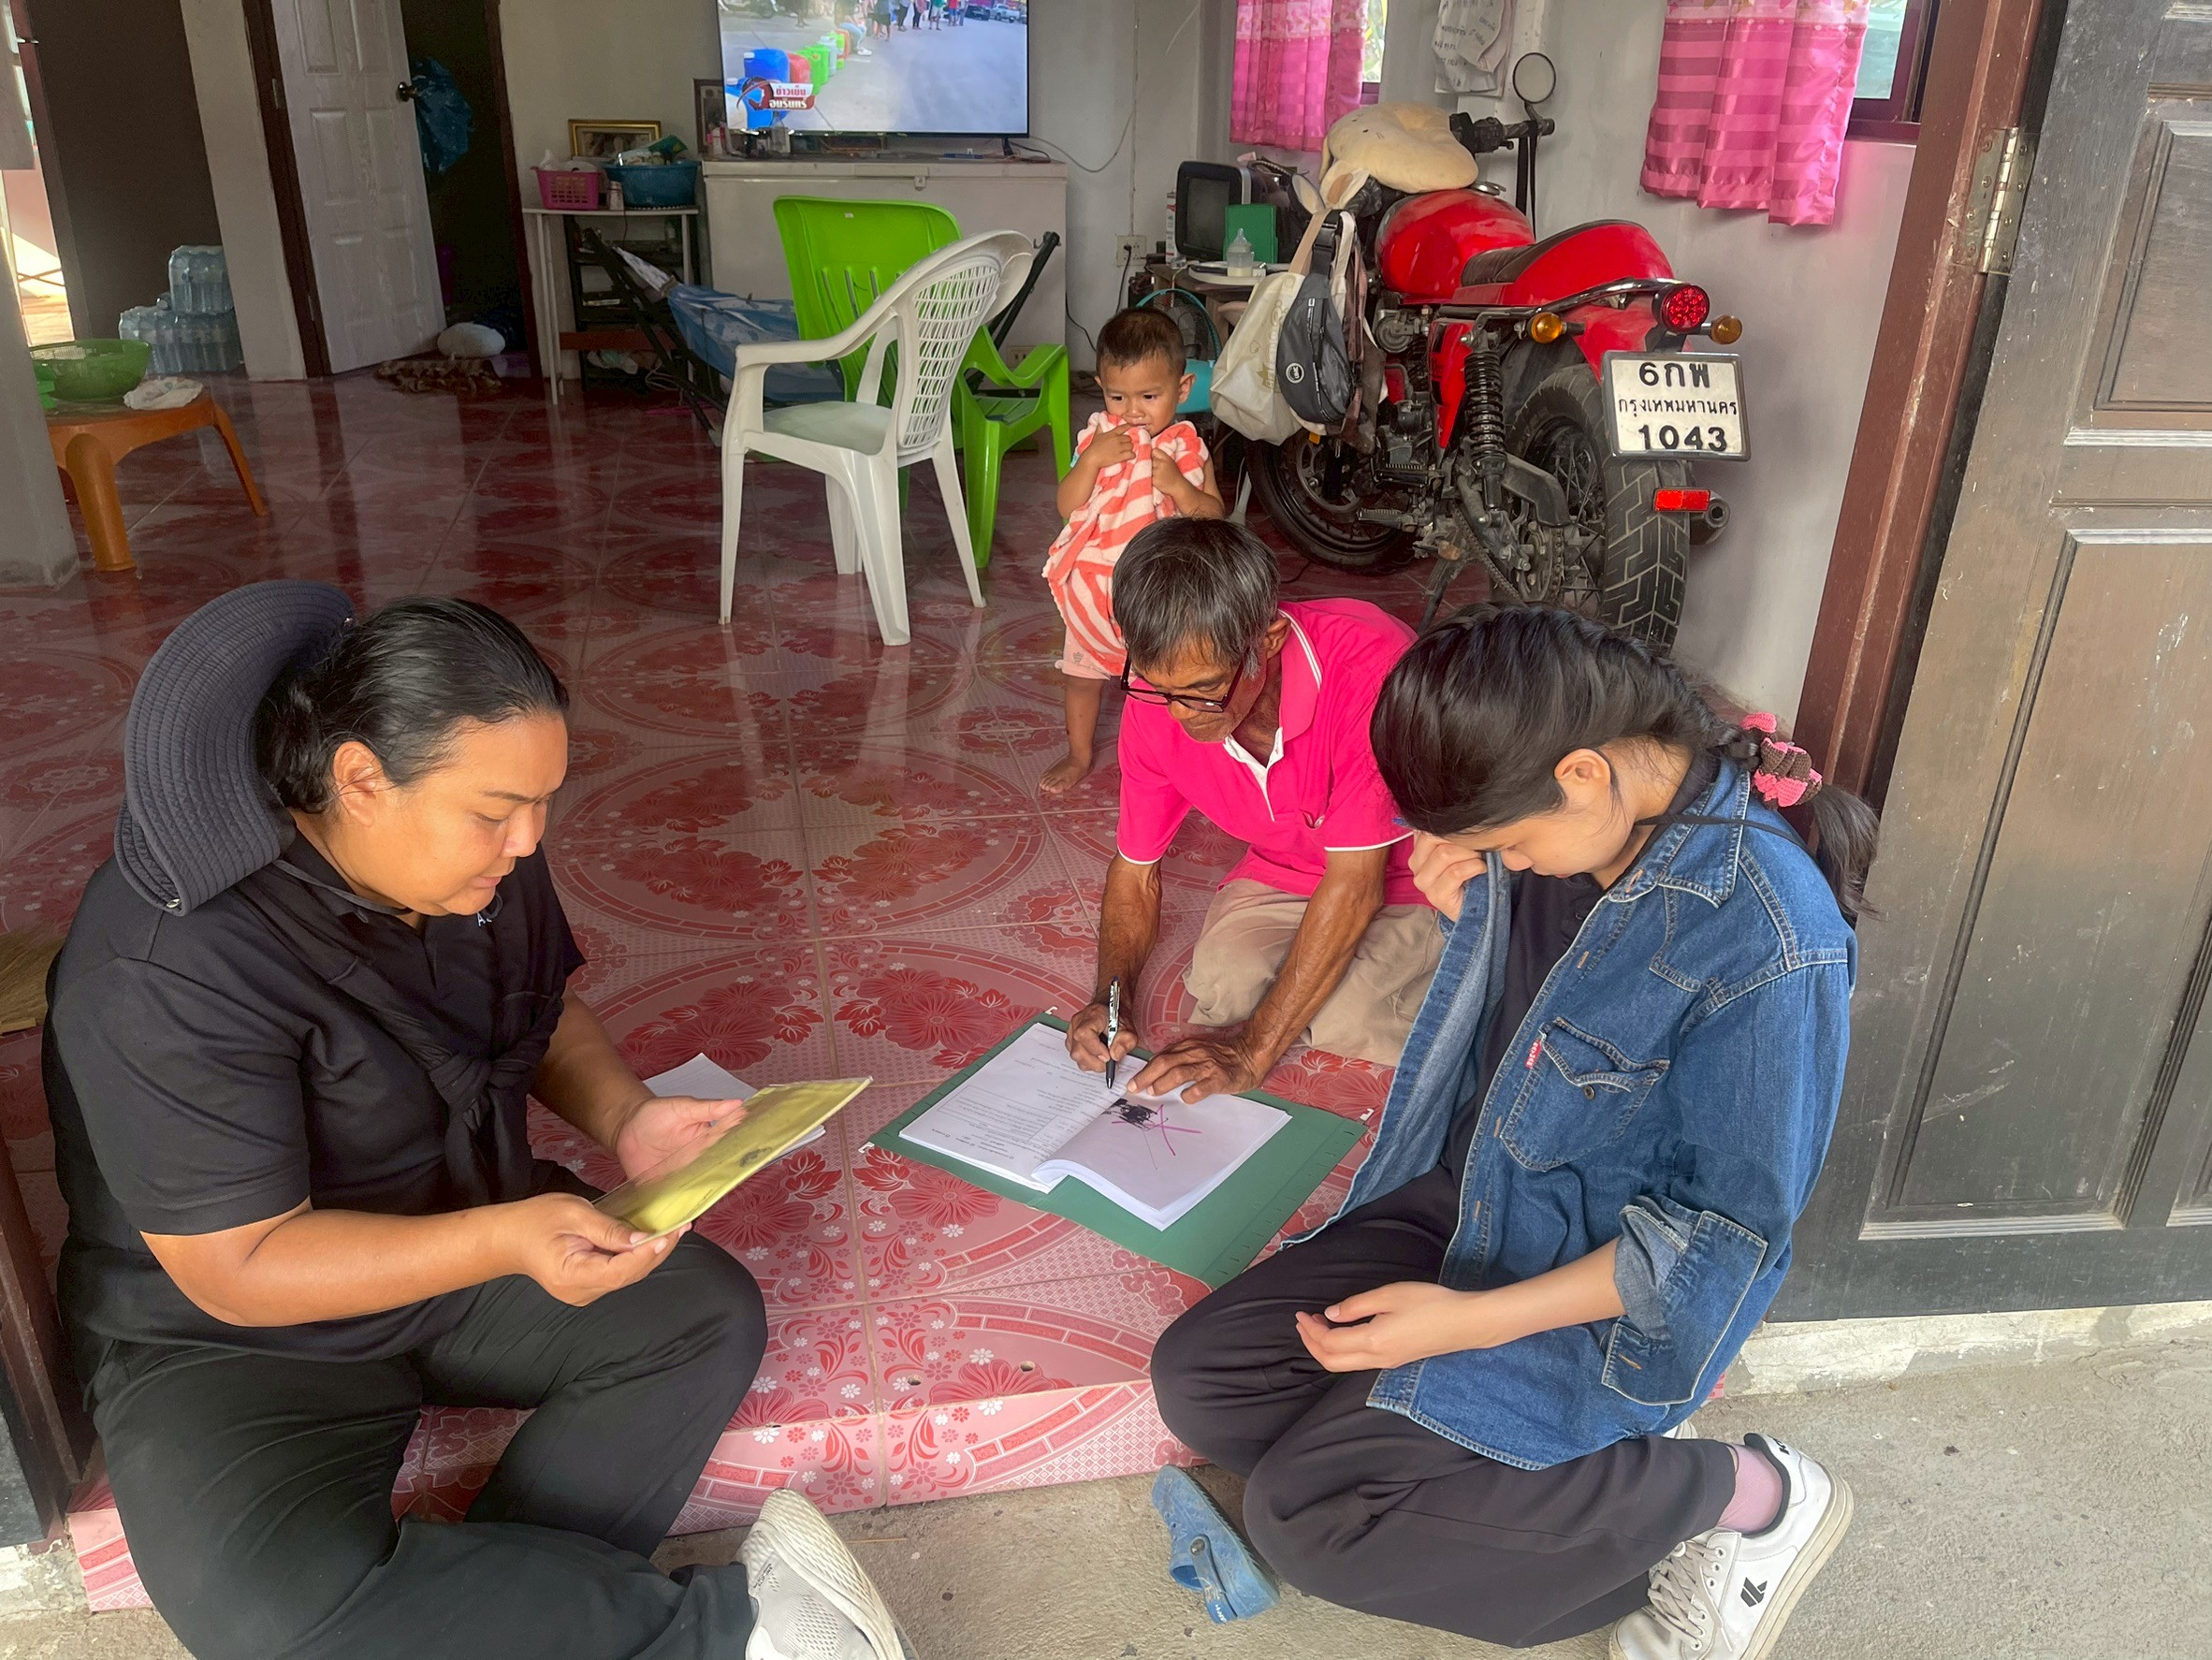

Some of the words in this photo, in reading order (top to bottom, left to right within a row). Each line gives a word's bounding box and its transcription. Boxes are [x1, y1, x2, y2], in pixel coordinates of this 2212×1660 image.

[1639, 362, 1710, 388] 6กพ
[1619, 399, 1738, 417] กรุงเทพมหานคร
[1638, 425, 1727, 452] 1043
